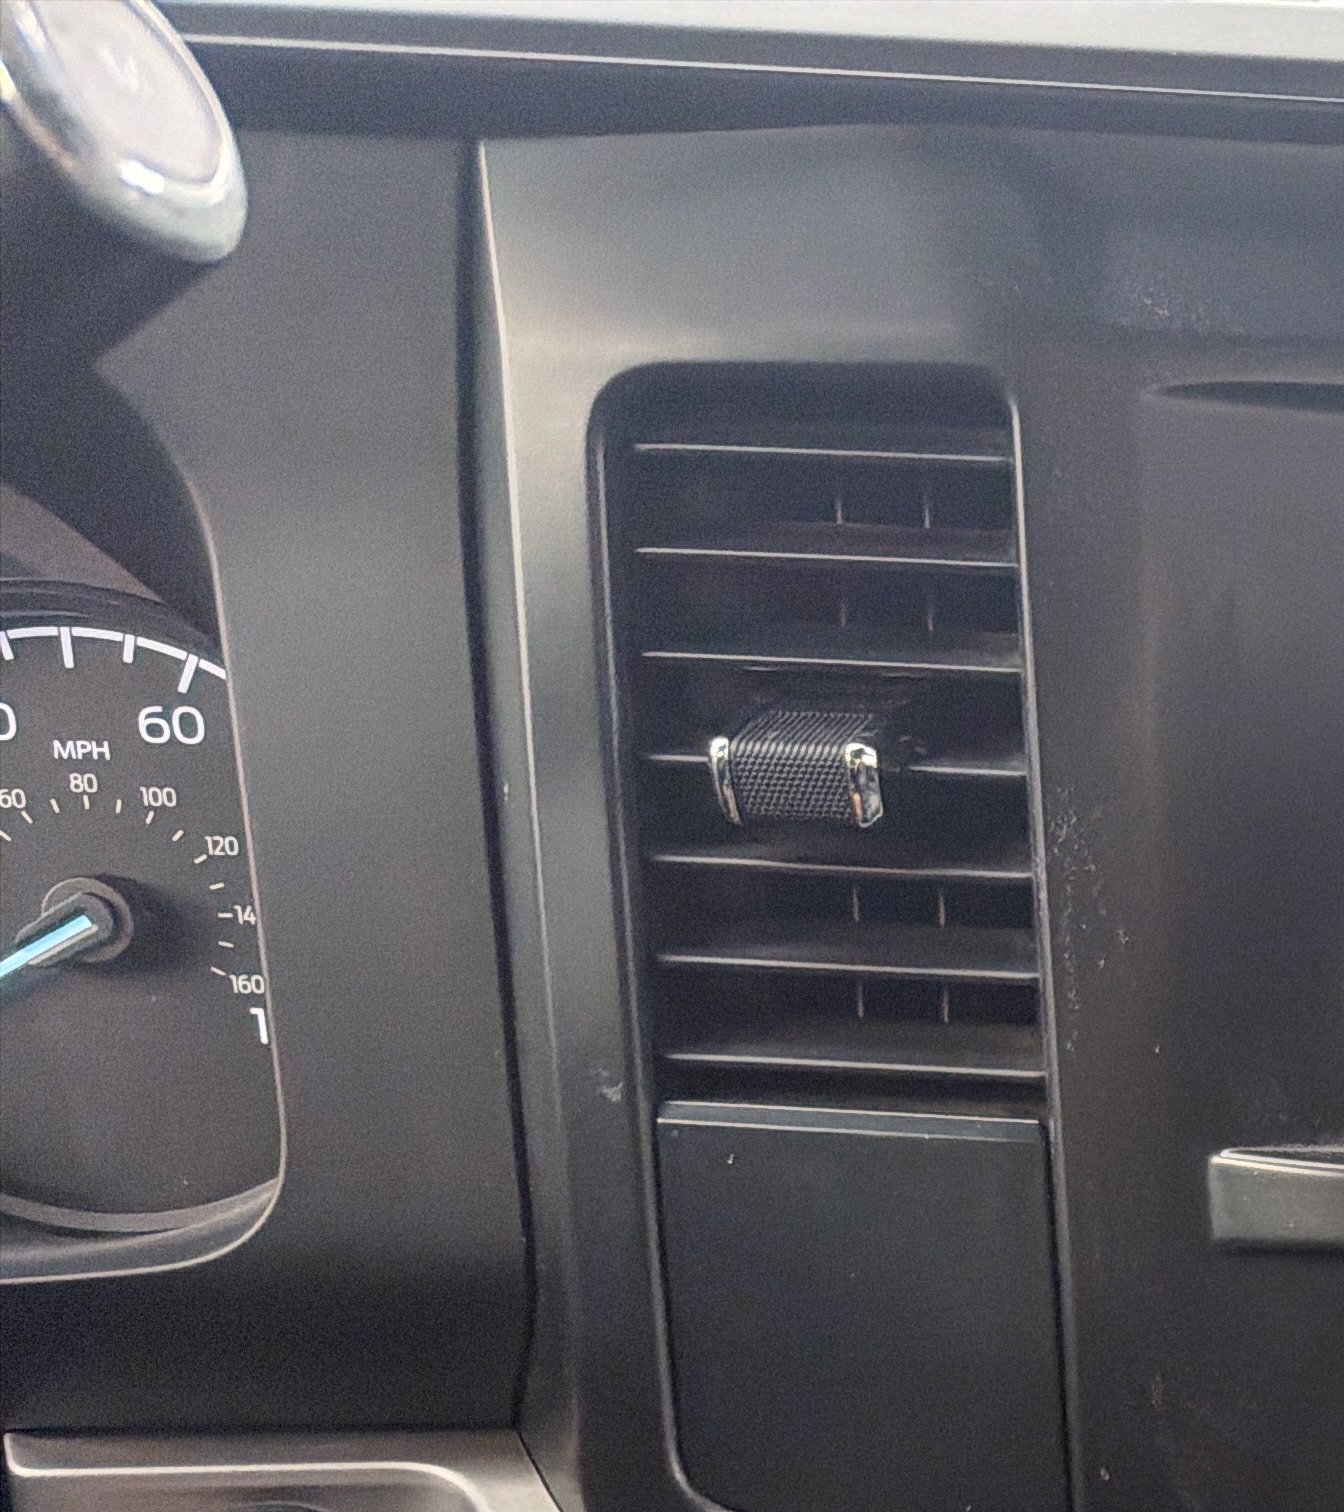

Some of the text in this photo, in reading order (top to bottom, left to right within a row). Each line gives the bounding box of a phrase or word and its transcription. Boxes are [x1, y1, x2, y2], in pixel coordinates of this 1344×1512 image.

[138, 706, 205, 744] 60
[53, 740, 110, 760] MPH
[69, 773, 97, 792] 80
[0, 788, 26, 808] 60
[140, 787, 177, 807] 100
[205, 836, 239, 855] 120
[229, 975, 265, 994] 160
